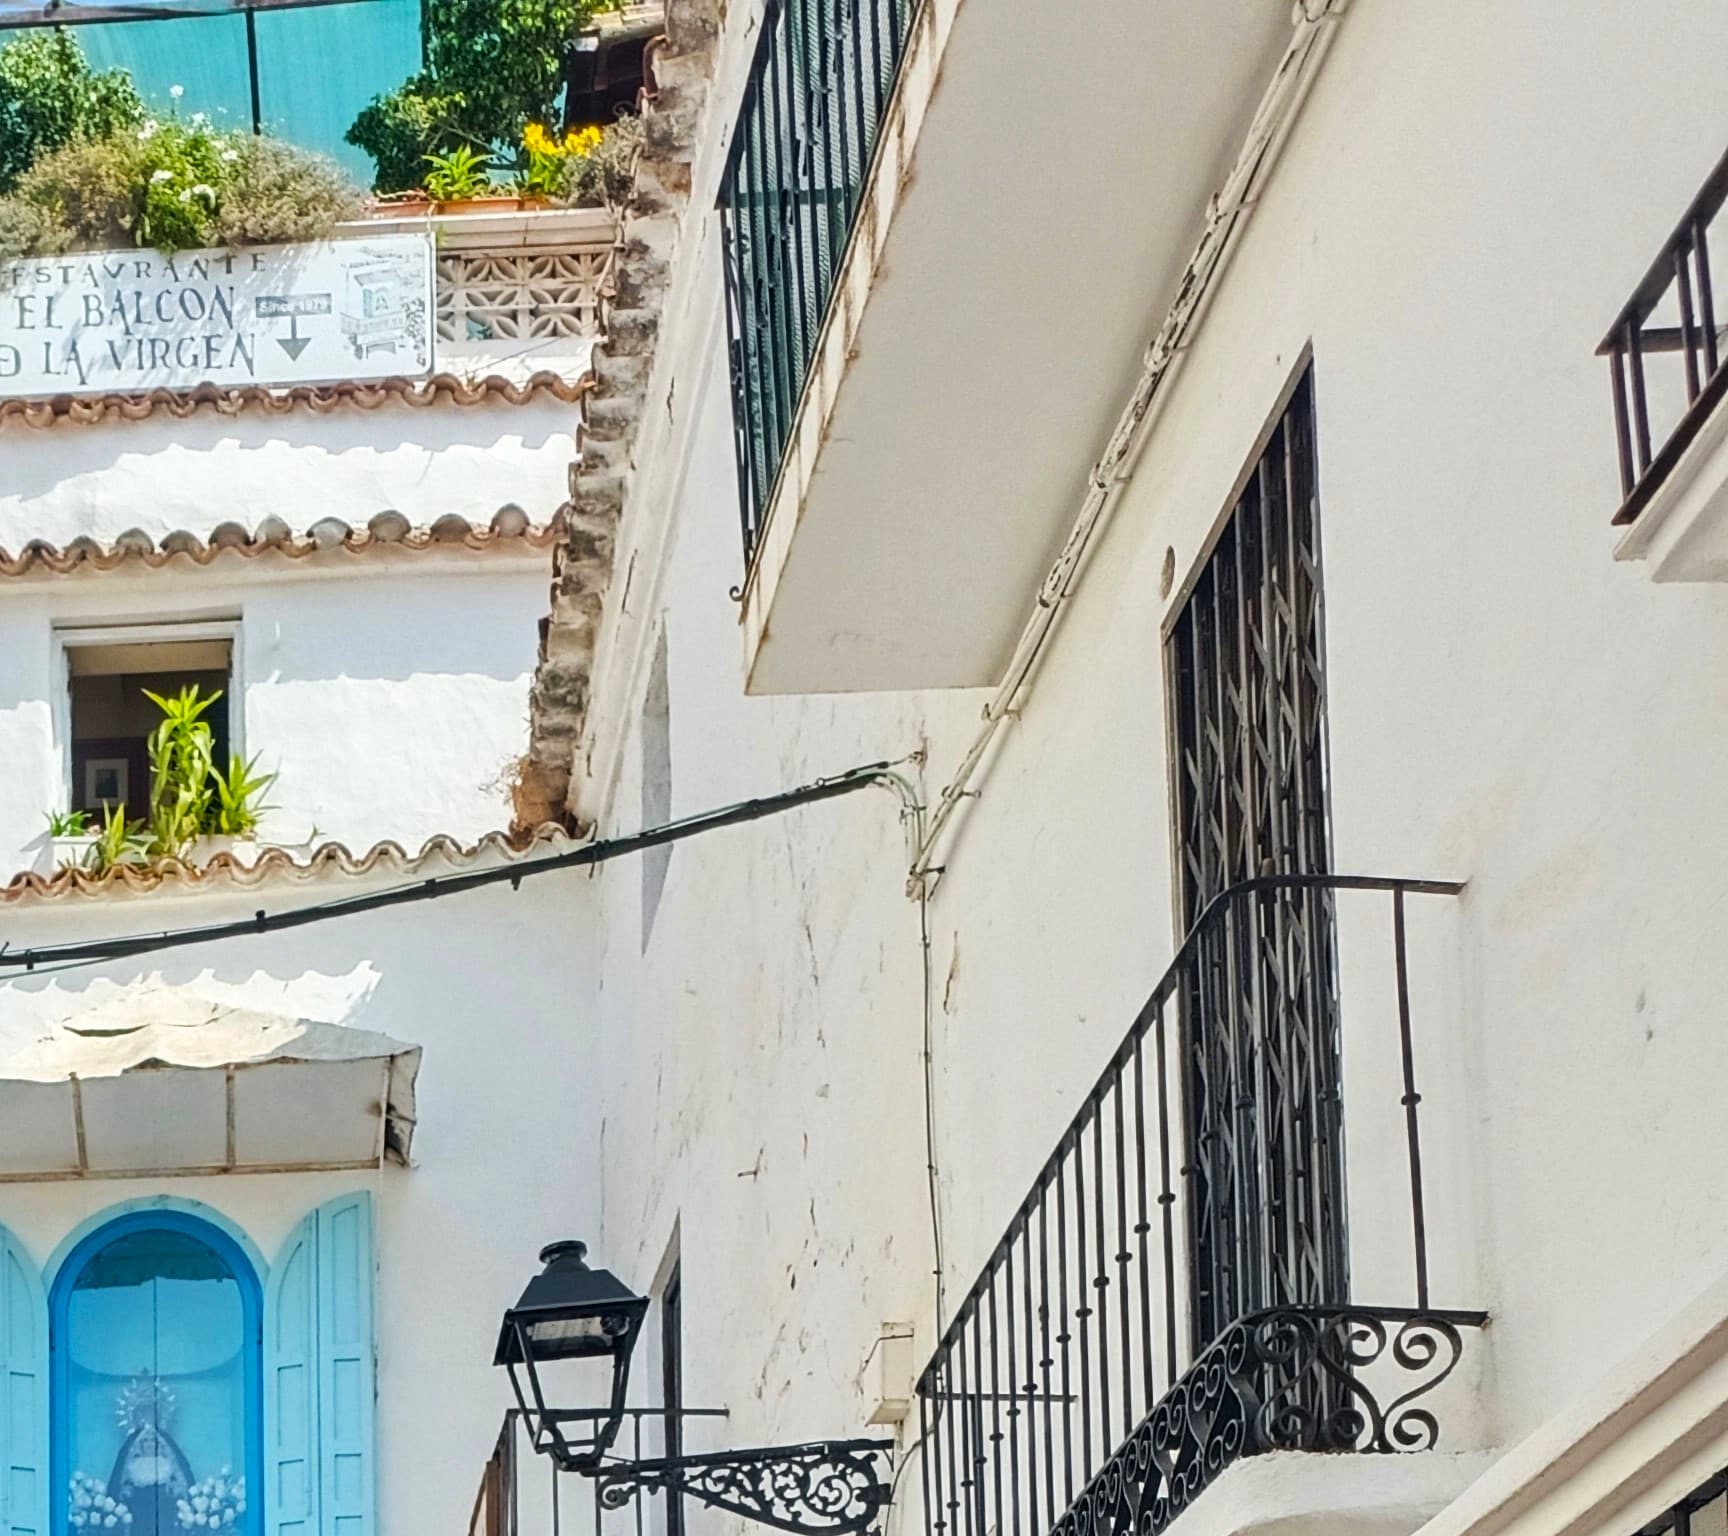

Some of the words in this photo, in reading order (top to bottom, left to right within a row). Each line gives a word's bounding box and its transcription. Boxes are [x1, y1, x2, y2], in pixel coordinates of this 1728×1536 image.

[14, 294, 63, 330] EL
[81, 284, 235, 336] BALCON
[258, 300, 295, 313] Since
[42, 336, 87, 386] LA
[106, 331, 255, 377] VIRGEN
